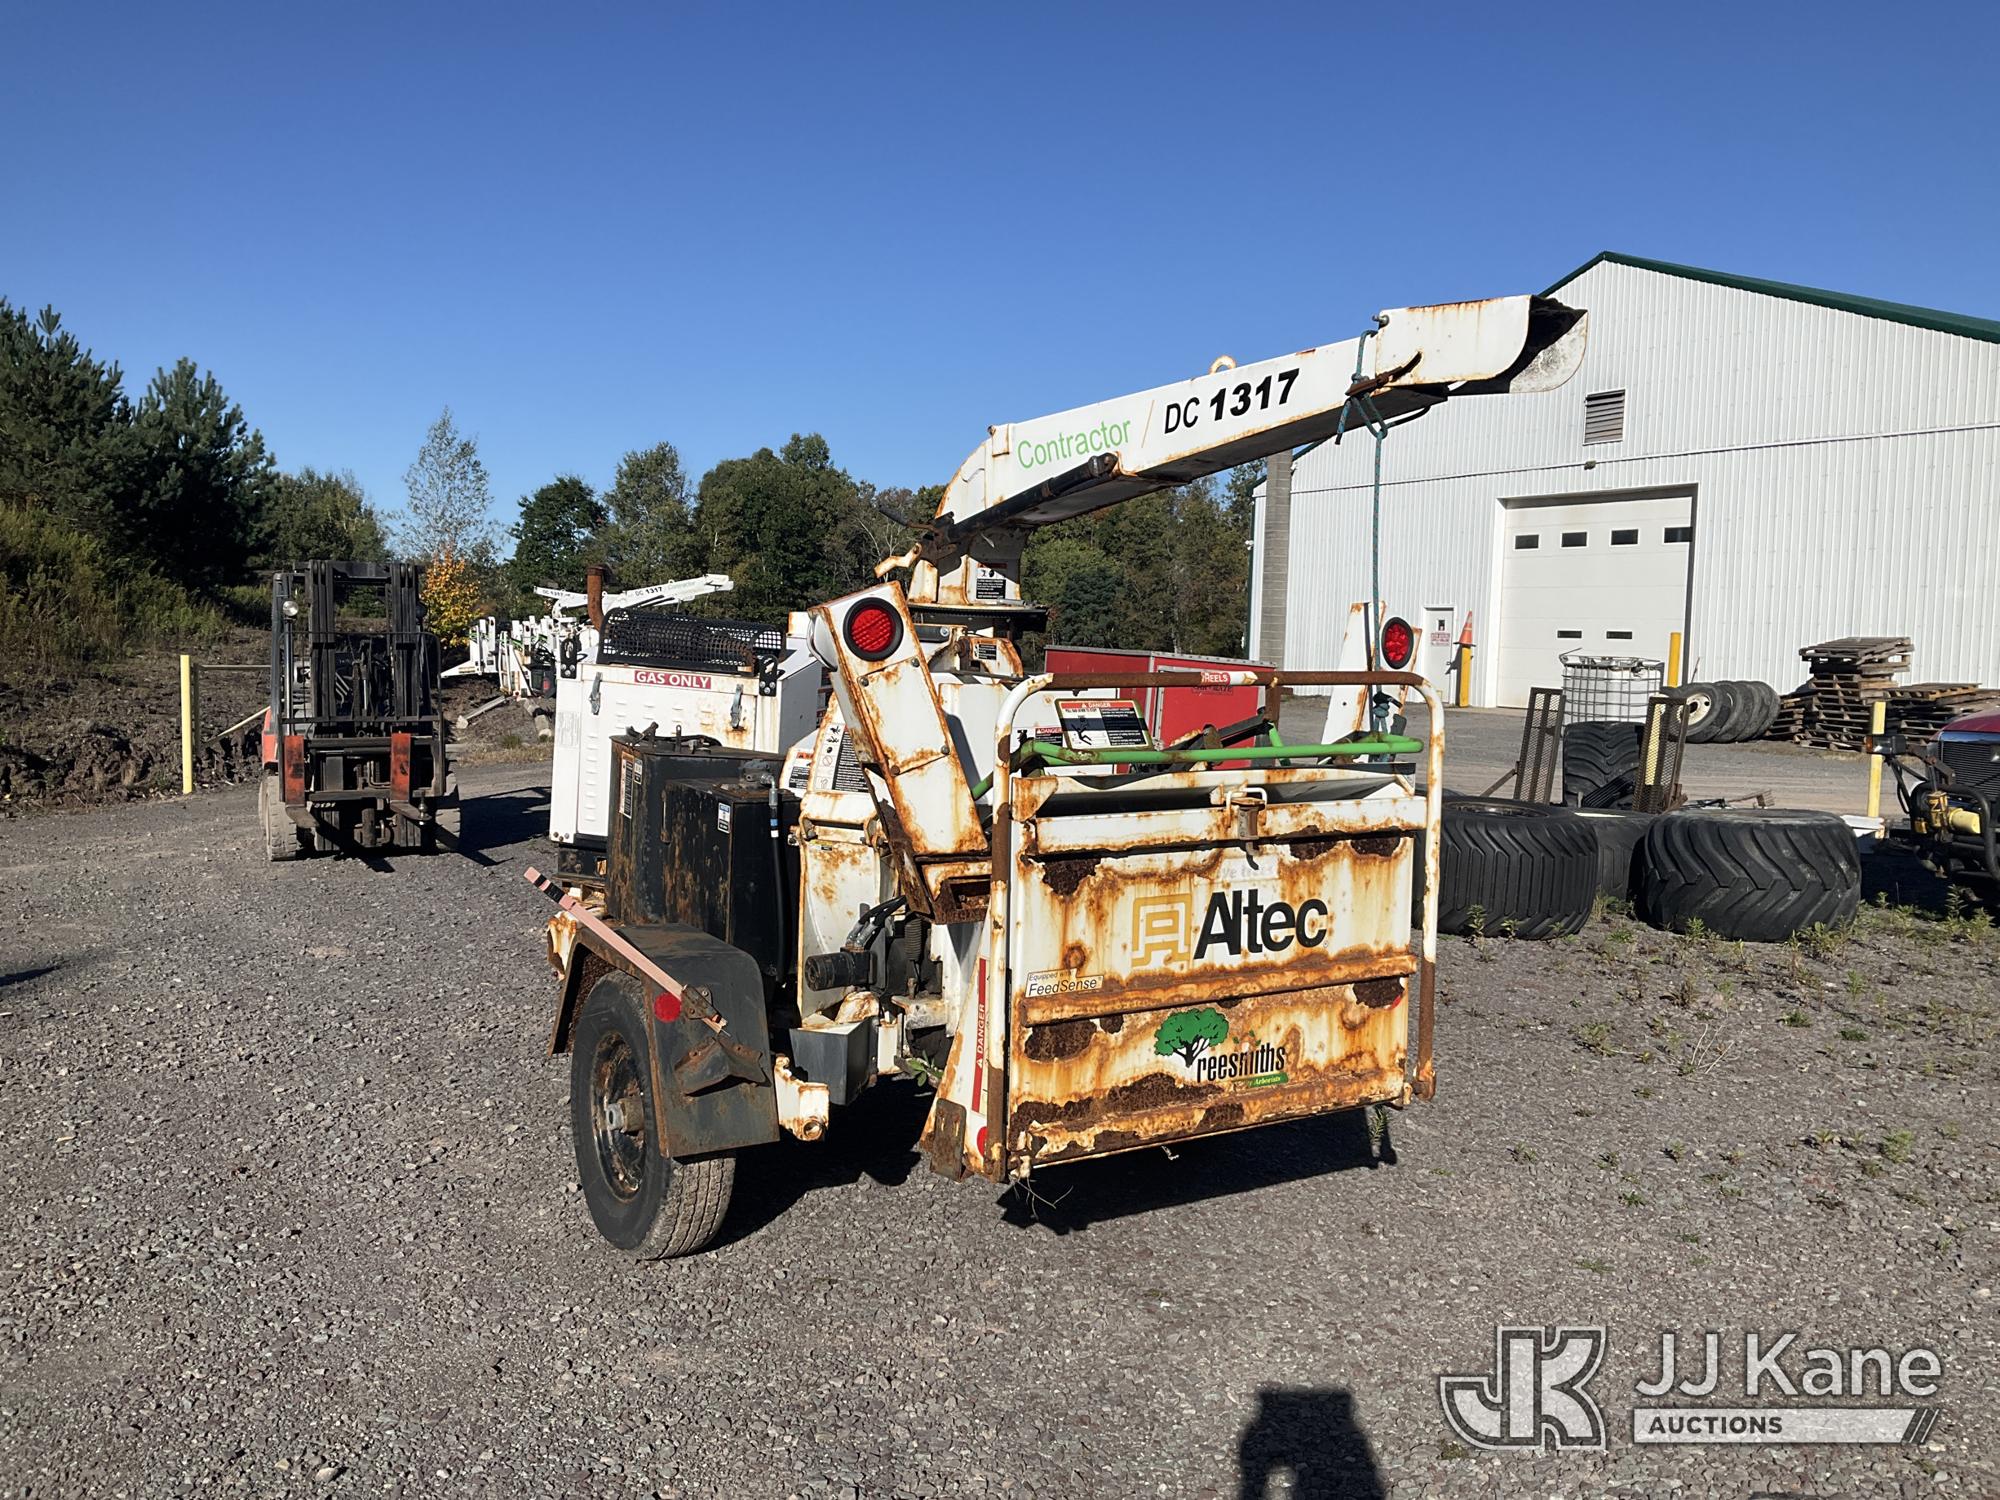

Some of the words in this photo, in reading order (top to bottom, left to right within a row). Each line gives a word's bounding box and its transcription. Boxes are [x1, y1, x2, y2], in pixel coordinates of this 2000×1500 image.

[1018, 420, 1131, 469] Contractor
[1164, 397, 1200, 434] DC
[1209, 368, 1300, 422] 1317
[645, 586, 662, 595] 1317
[636, 671, 665, 685] GAS
[669, 674, 710, 689] ONLY
[1193, 888, 1328, 960] Altec
[1028, 979, 1097, 996] FeedSense
[977, 1004, 985, 1055] DANGER
